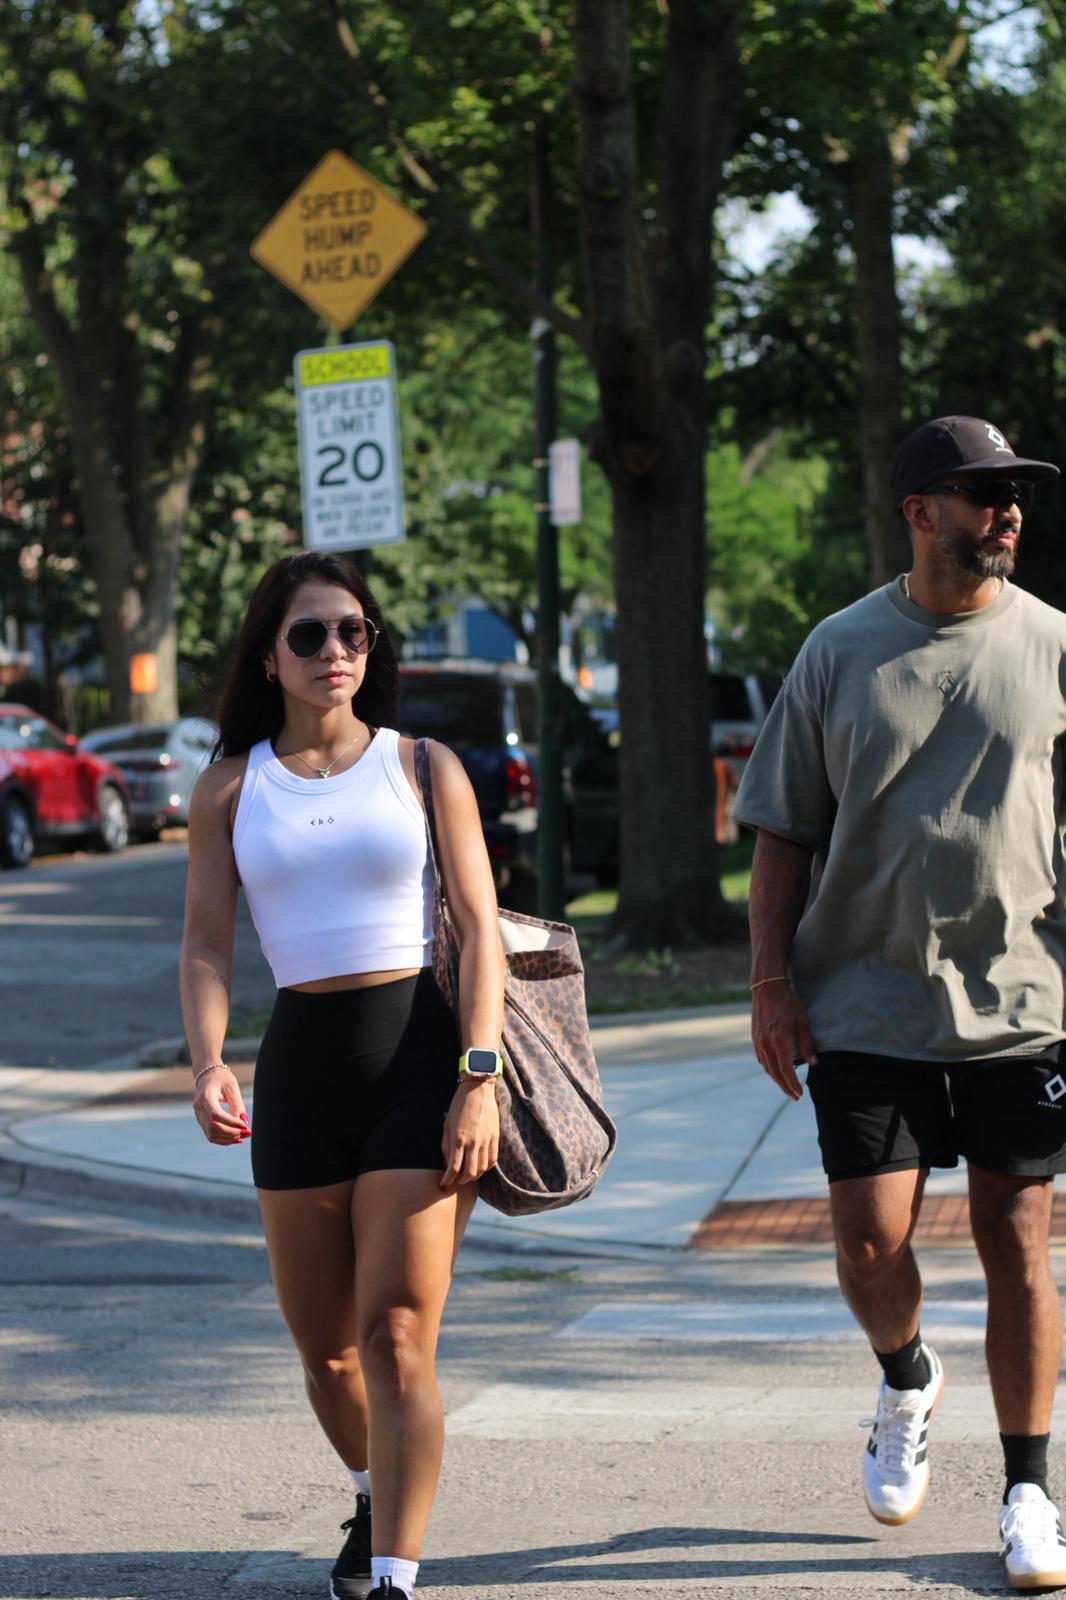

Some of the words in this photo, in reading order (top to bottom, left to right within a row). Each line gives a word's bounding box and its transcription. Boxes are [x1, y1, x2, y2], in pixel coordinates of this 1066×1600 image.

[301, 188, 376, 221] SPEED
[303, 219, 373, 252] HUMP
[302, 252, 382, 284] AHEAD
[305, 349, 382, 378] SCHOOL
[308, 385, 385, 415] SPEED
[317, 412, 377, 439] LIMIT
[316, 440, 385, 487] 20
